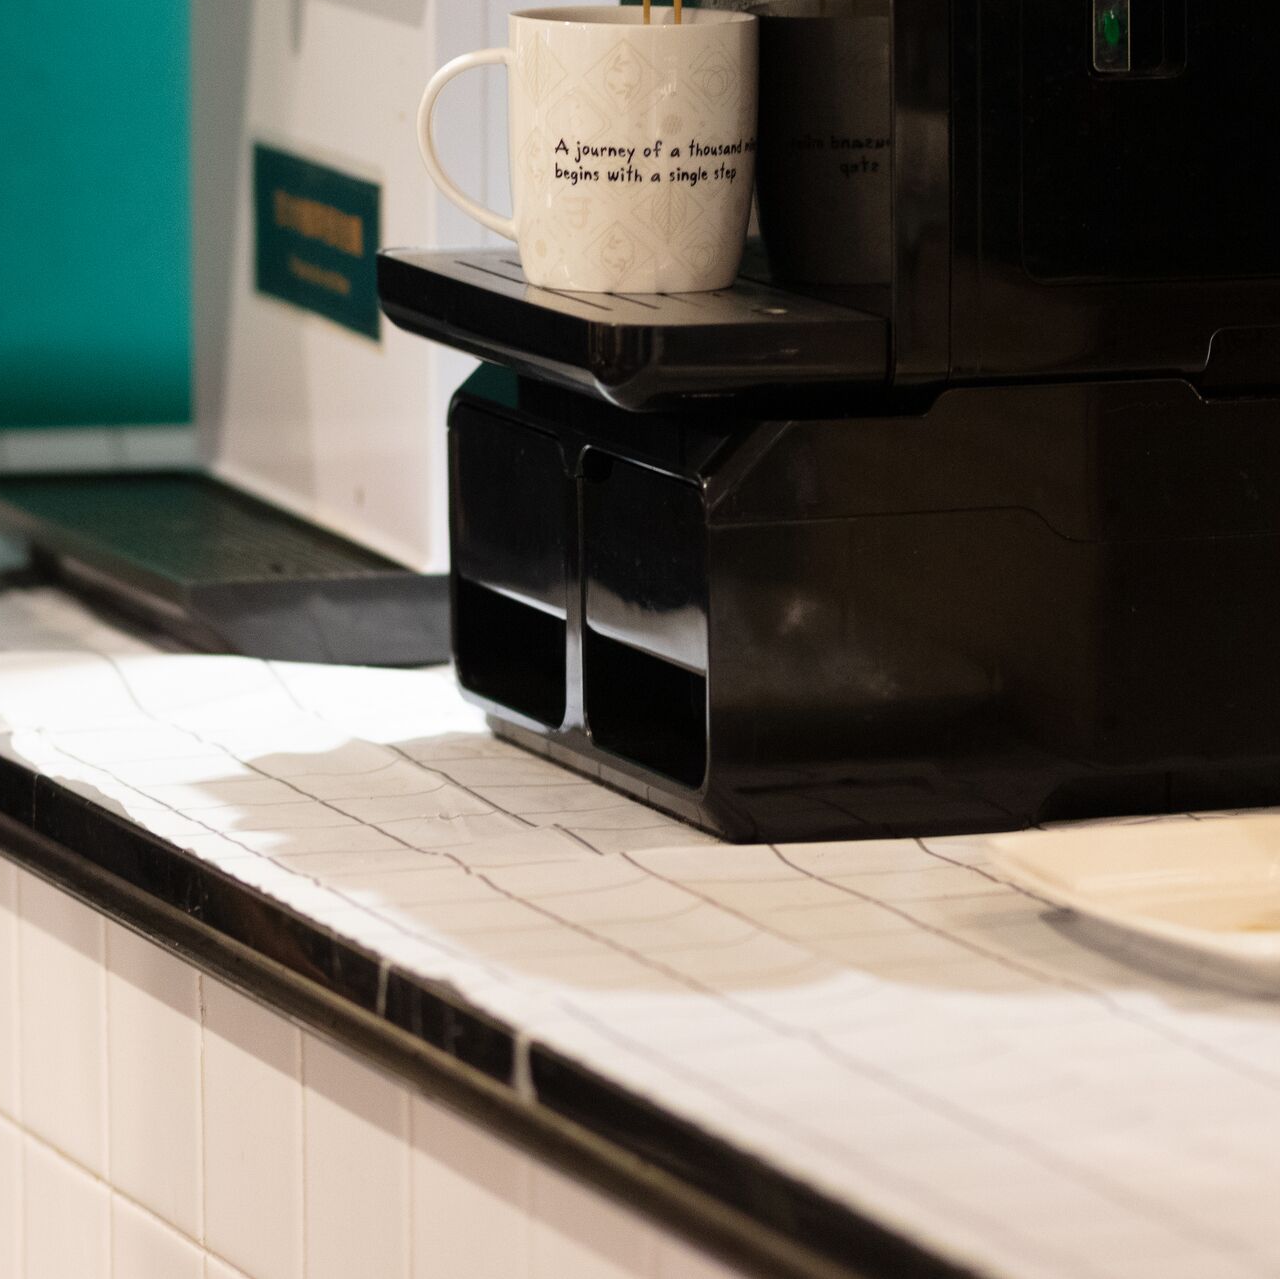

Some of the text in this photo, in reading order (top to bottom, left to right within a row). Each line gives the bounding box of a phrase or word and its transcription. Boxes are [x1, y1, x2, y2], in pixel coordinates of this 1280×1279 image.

[554, 138, 569, 155] A
[574, 140, 635, 163] journey
[643, 140, 663, 158] of
[670, 147, 680, 158] a
[688, 135, 742, 158] thousand
[554, 162, 737, 187] begins with a single step
